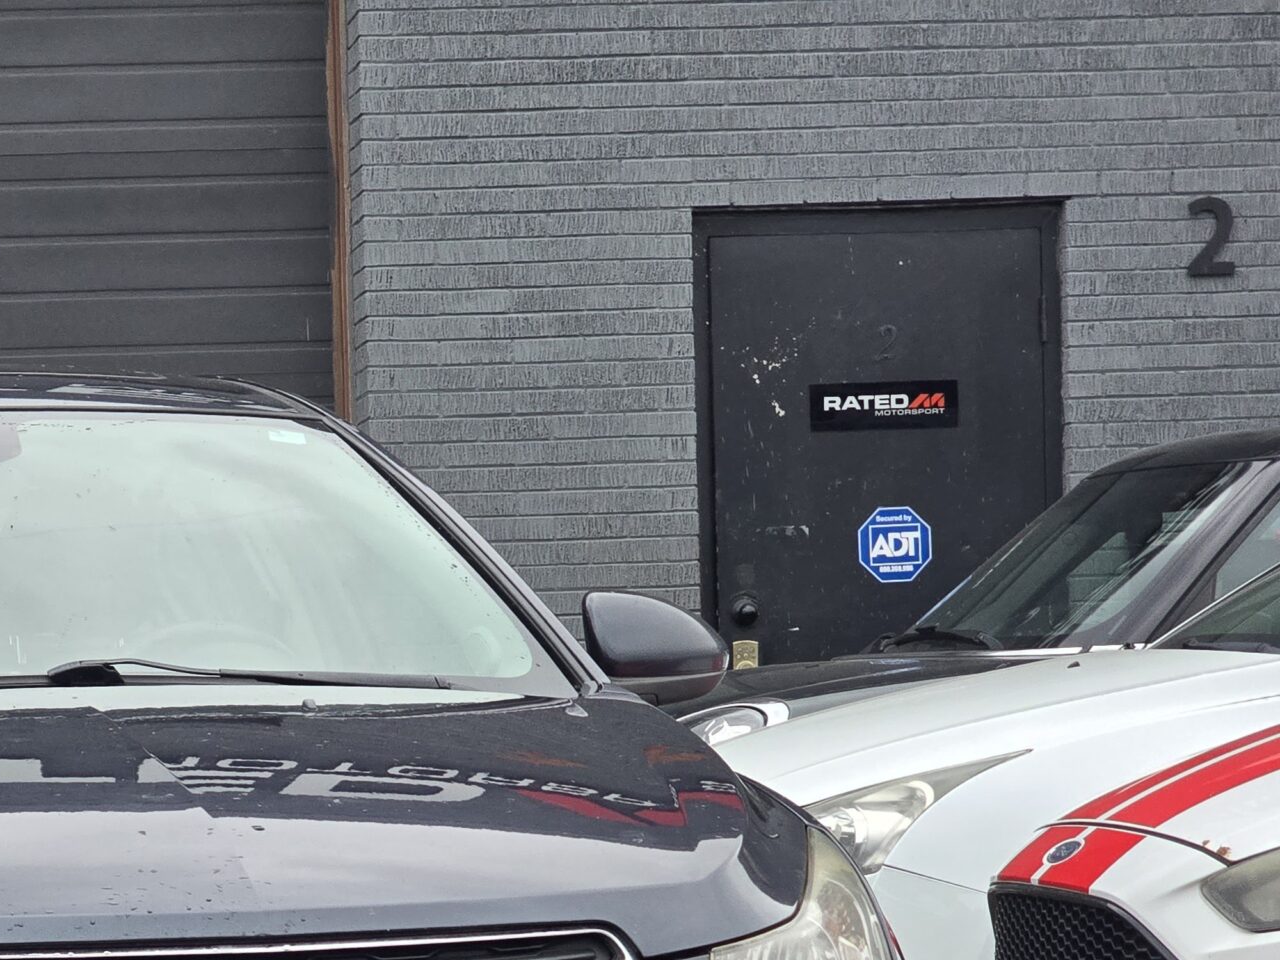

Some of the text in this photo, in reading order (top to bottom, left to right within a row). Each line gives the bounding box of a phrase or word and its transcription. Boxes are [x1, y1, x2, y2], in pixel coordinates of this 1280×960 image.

[1188, 196, 1235, 277] 2
[823, 393, 909, 412] RATED
[874, 407, 946, 417] MOTORSPORT
[875, 513, 912, 522] Secured by
[871, 530, 919, 558] ADT
